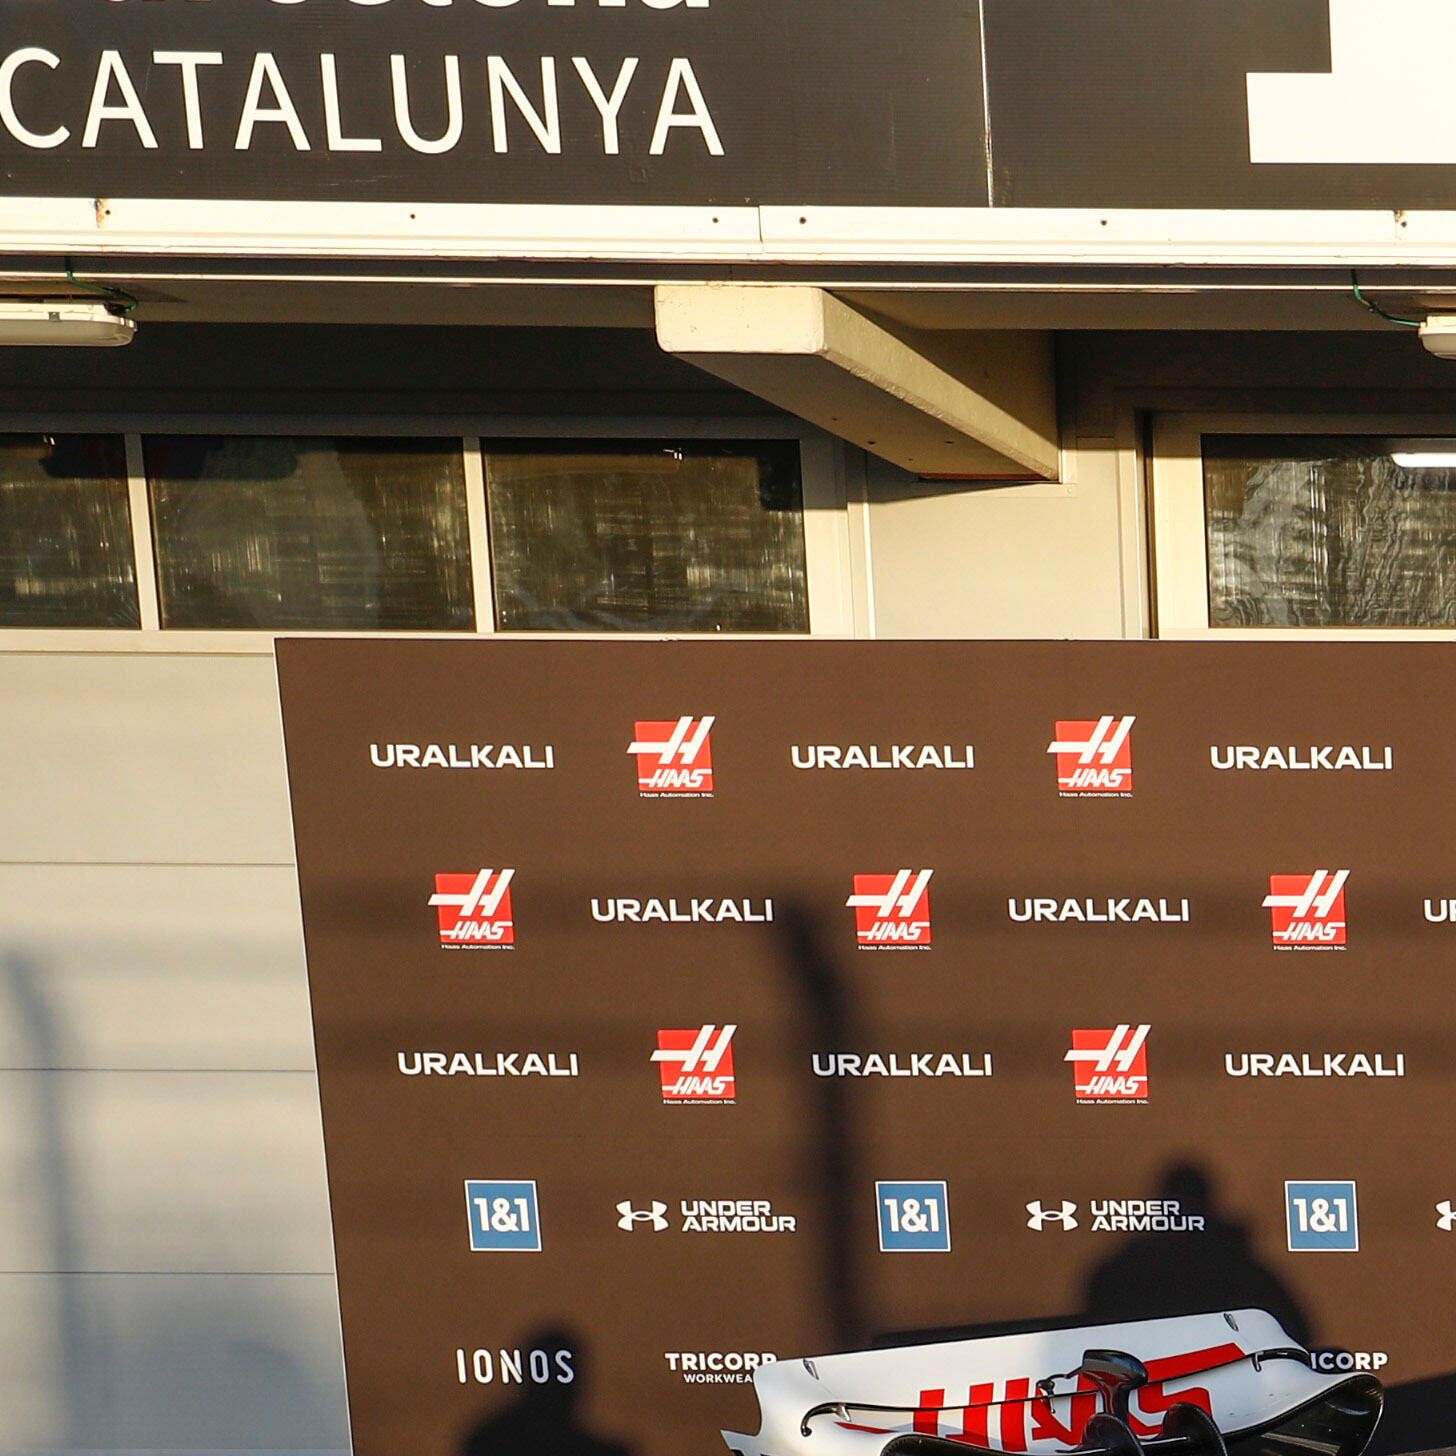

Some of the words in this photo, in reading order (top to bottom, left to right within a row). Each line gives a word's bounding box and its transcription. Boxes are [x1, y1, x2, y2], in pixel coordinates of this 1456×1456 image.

[0, 47, 724, 156] CATALUNYA
[371, 745, 553, 768] URALKALI
[792, 746, 973, 768] URALKALI
[1211, 747, 1392, 769] URALKALI
[639, 769, 713, 788] HAAS
[1059, 769, 1132, 788] HAAS
[591, 899, 772, 921] URALKALI
[1009, 899, 1188, 921] URALKALI
[441, 922, 513, 940] HAAS
[858, 922, 930, 940] HAAS
[1273, 923, 1346, 941] HAAS
[398, 1053, 578, 1075] URALKALI
[813, 1054, 991, 1075] URALKALI
[1226, 1054, 1404, 1076] URALKALI
[663, 1077, 735, 1095] HAAS
[1076, 1077, 1148, 1095] HAAS
[475, 1198, 530, 1231] 1&1
[681, 1201, 770, 1216] UNDER
[885, 1198, 941, 1232] 1&1
[1091, 1201, 1179, 1216] UNDER
[1294, 1199, 1348, 1232] 1&1
[682, 1215, 795, 1231] ARMOUR
[1092, 1215, 1204, 1231] ARMOUR
[457, 1349, 574, 1384] IONOS
[1310, 1353, 1388, 1370] ICORP
[684, 1374, 753, 1384] WORKWEA
